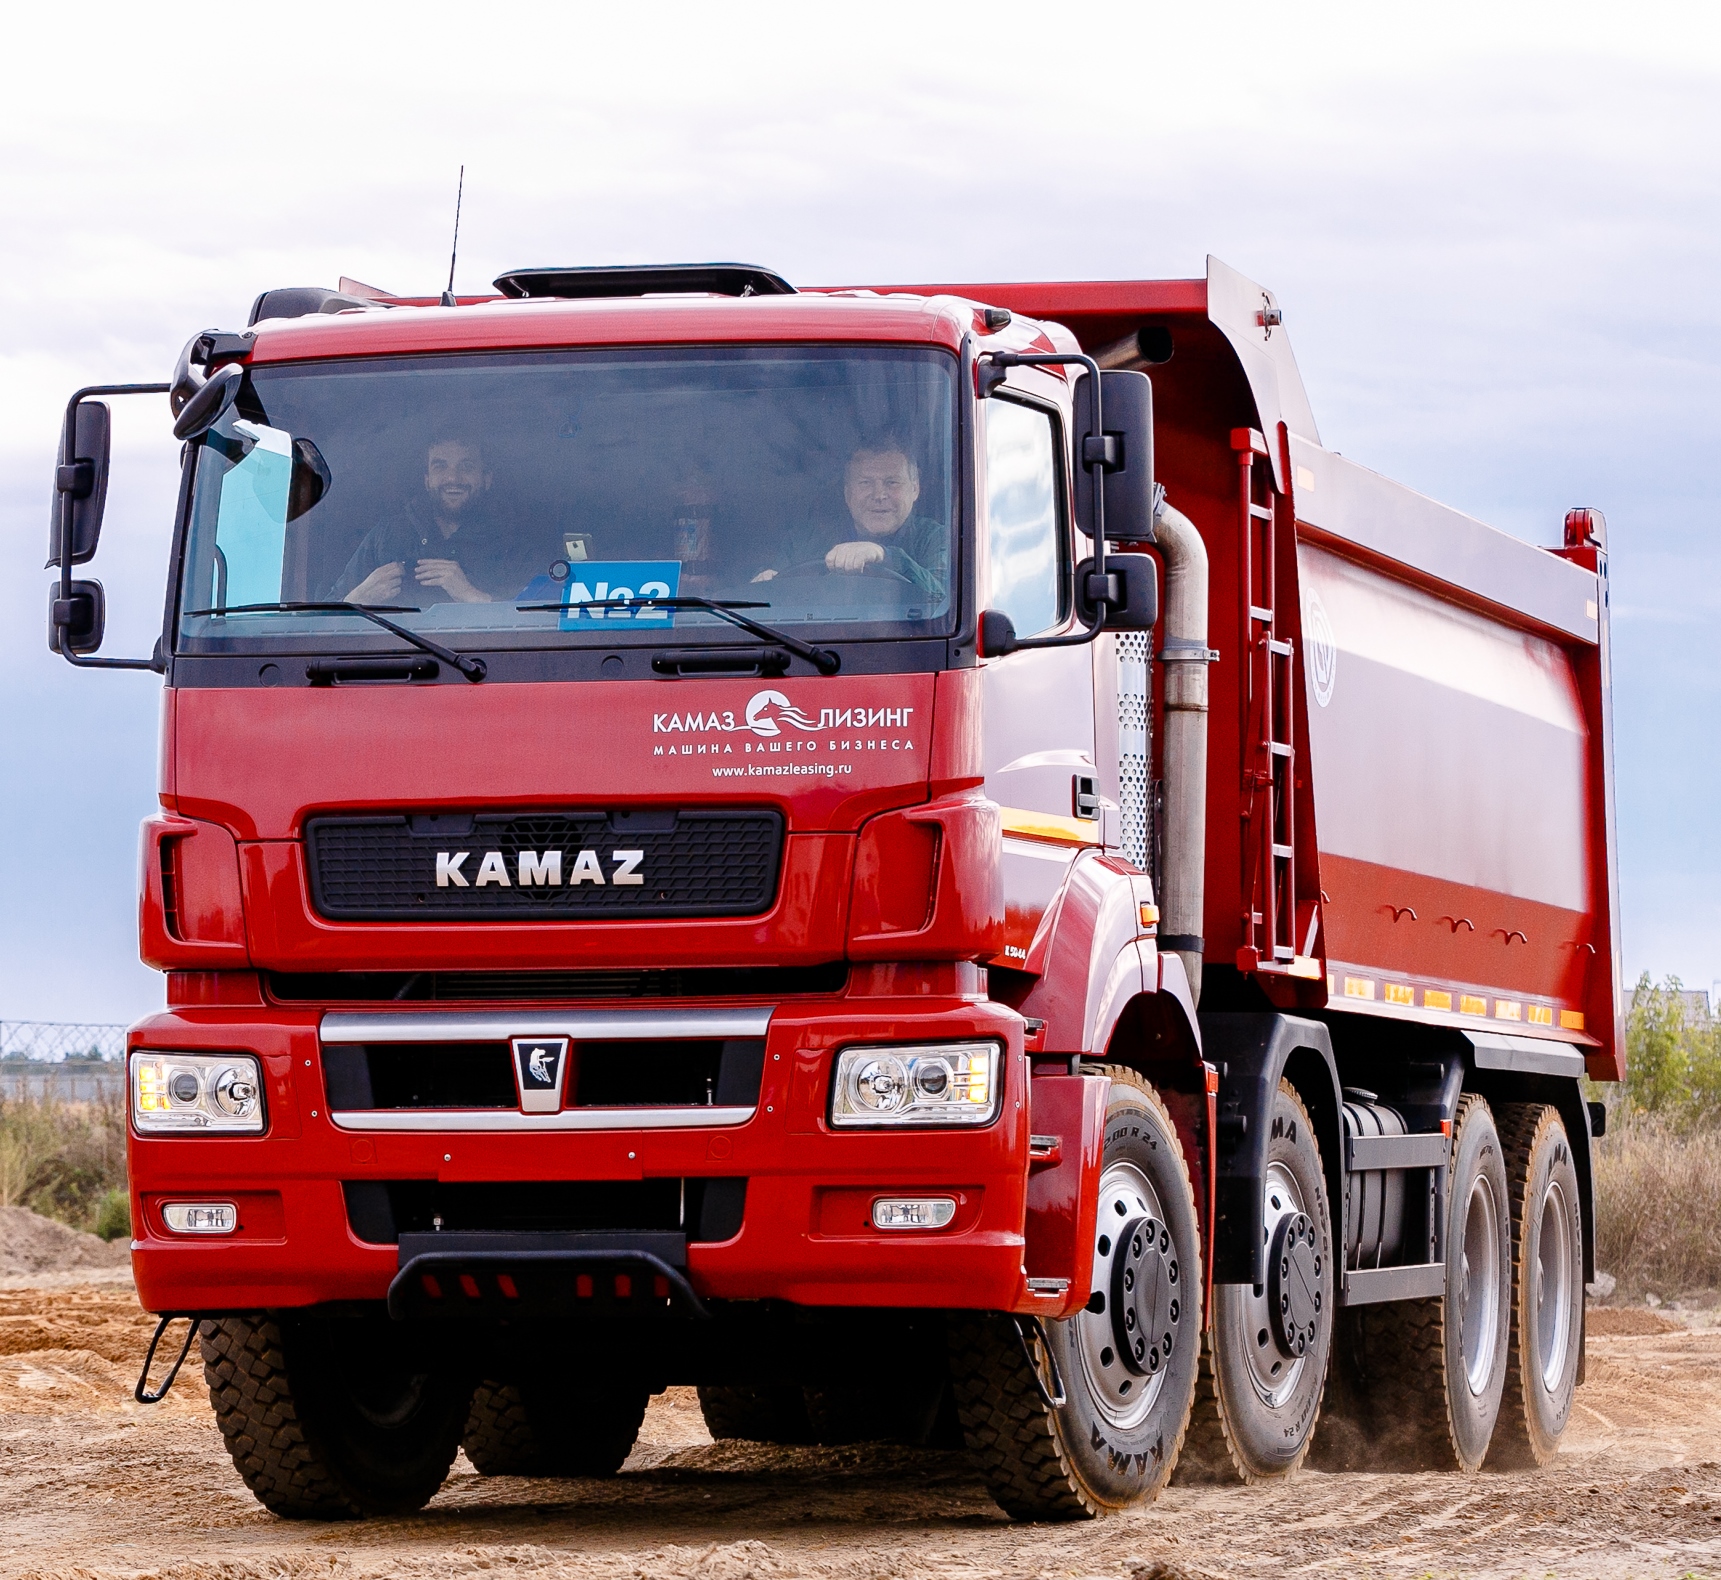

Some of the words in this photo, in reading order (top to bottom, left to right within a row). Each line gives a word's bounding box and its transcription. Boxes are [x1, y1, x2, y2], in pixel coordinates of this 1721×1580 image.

[653, 711, 735, 733] КАМАЗ
[817, 708, 914, 728] ЛИЗИНГ
[653, 743, 733, 756] МАШИНА
[745, 741, 817, 753] ВАШЕГО
[829, 740, 914, 751] БИЗНЕСА
[712, 763, 852, 778] www.kamazleasing.ru
[436, 850, 644, 887] KAMAZ
